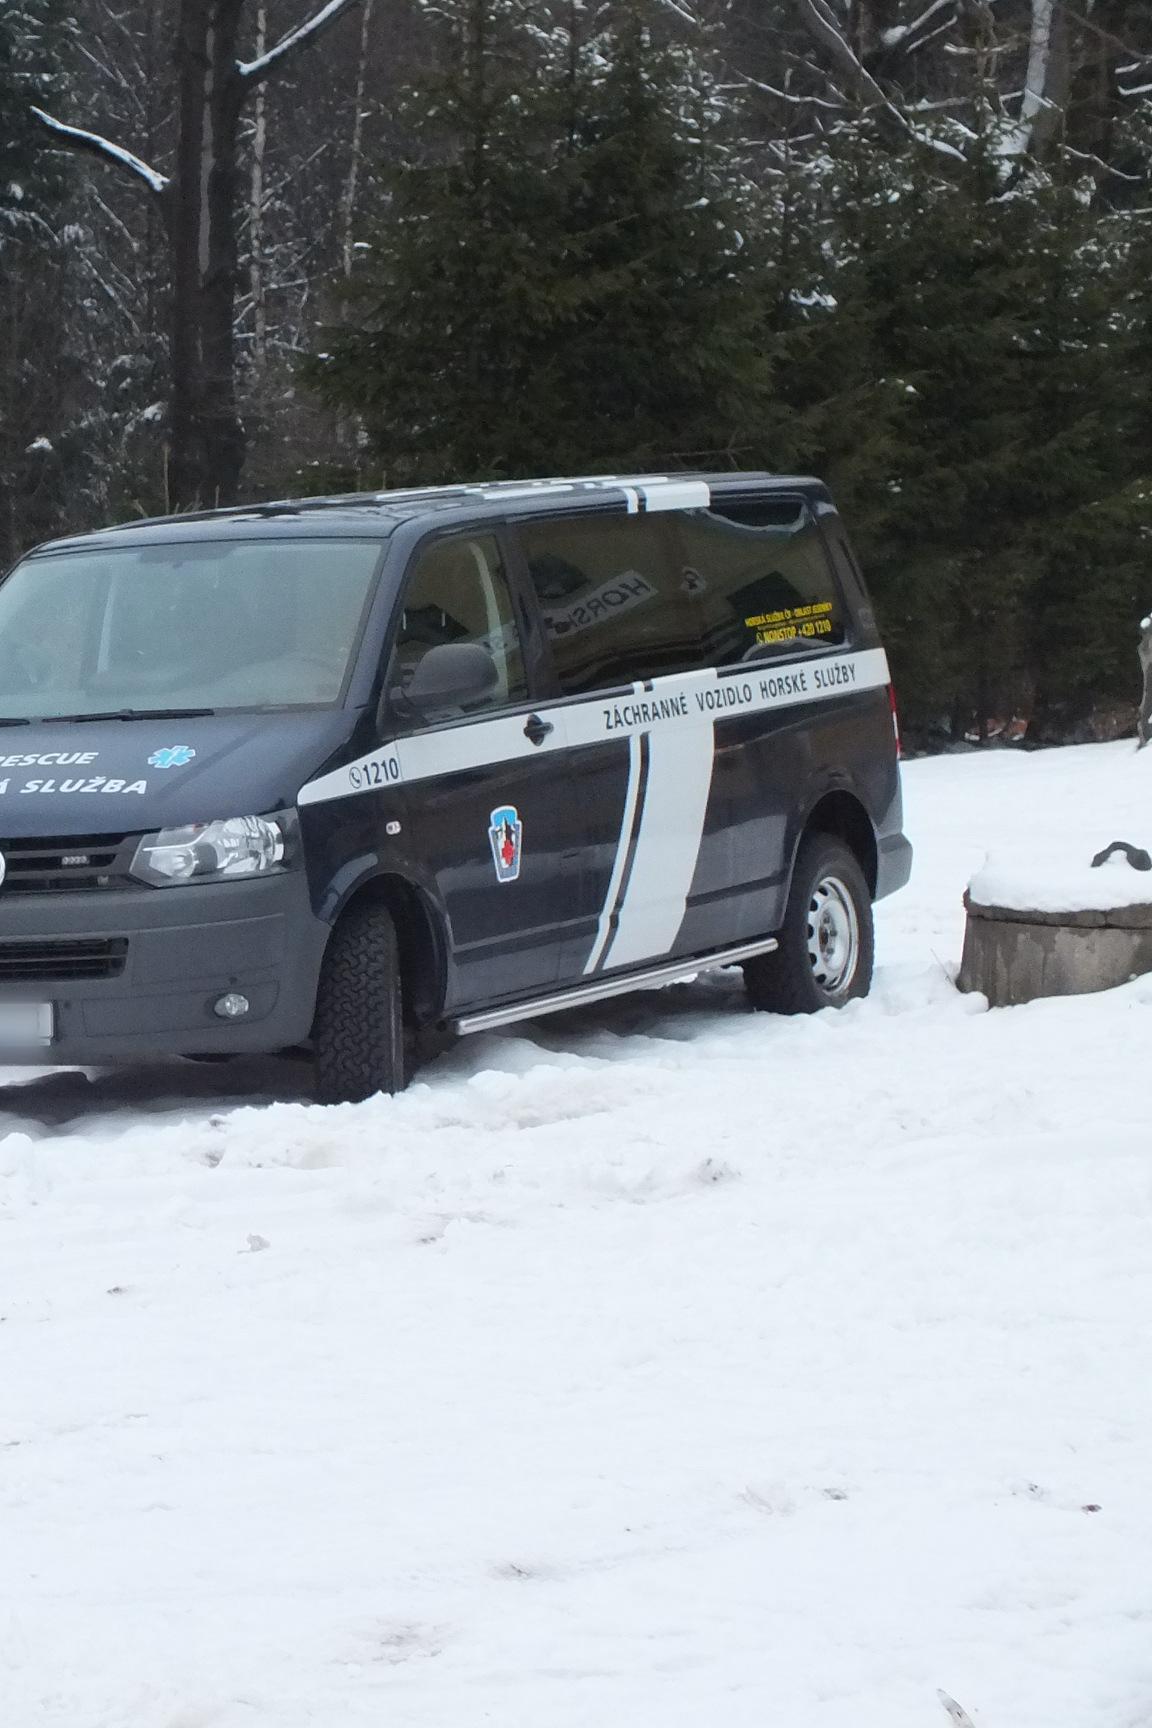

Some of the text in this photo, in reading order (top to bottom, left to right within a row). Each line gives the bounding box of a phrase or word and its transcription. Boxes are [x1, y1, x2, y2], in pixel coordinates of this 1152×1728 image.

[603, 662, 857, 730] ZÁCHRANNÉ VOZIDLO HORSKÉ SLUŽBY
[363, 758, 399, 785] 1210
[20, 776, 147, 795] SLUŽBA
